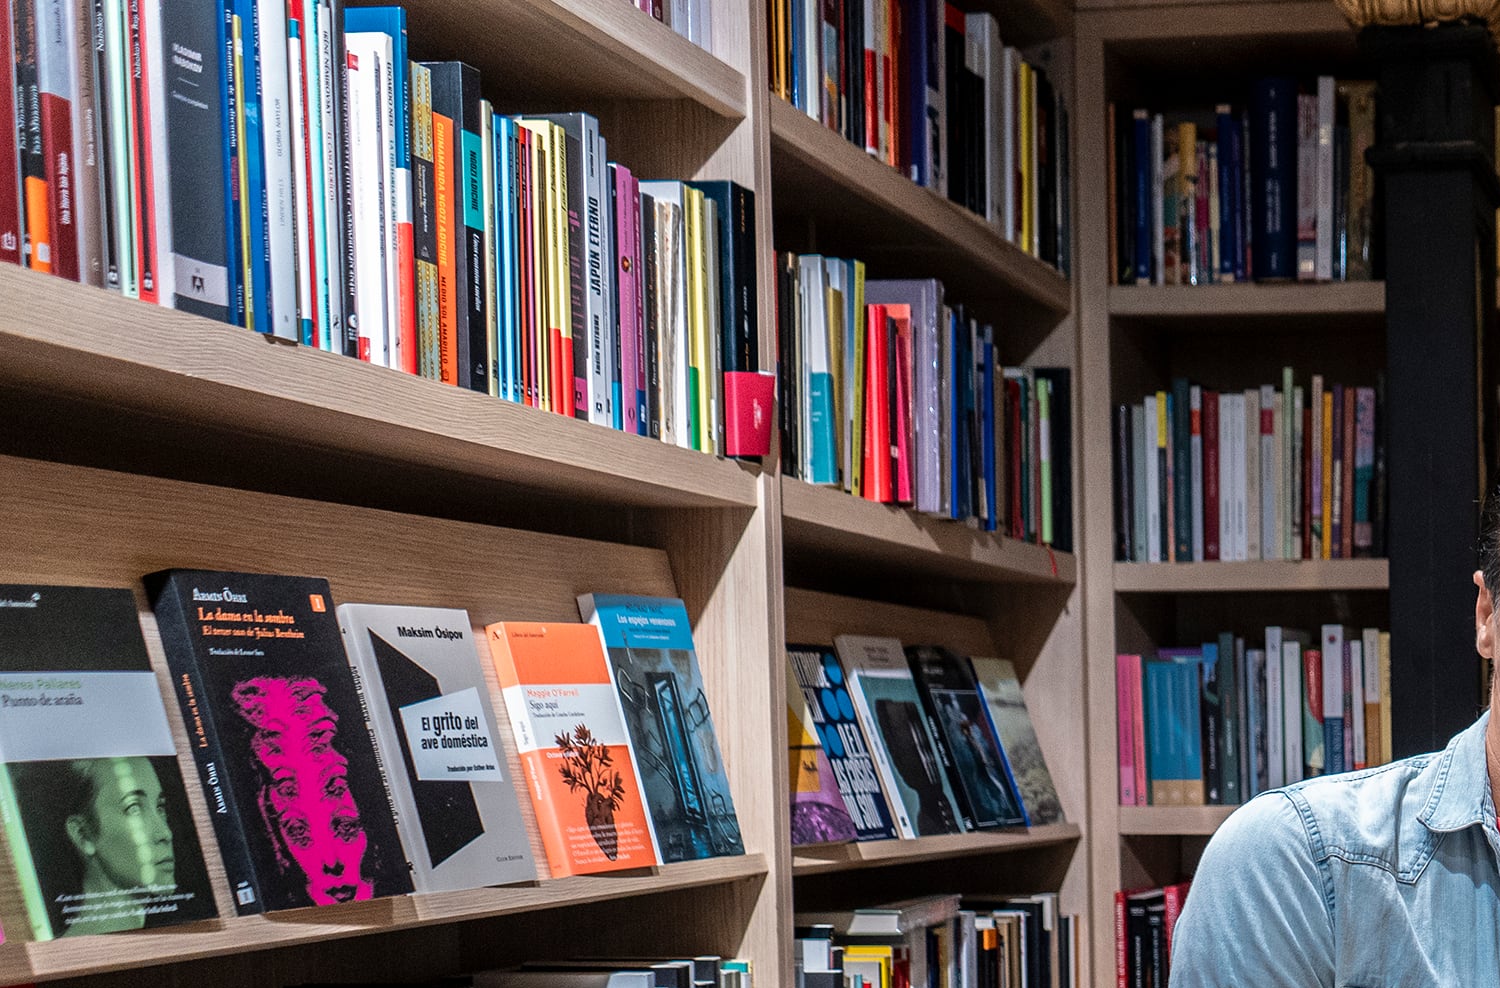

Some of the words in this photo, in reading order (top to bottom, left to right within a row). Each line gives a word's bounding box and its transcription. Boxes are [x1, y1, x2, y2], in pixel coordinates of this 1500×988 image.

[435, 122, 447, 193] CHIMAMANDA
[468, 149, 480, 175] NGOZI
[437, 194, 448, 222] NGOZI
[469, 177, 481, 212] ADICHIE
[588, 196, 600, 248] ETERNO
[438, 223, 448, 267] ADICHIE
[589, 250, 602, 297] JAPÓN
[440, 275, 448, 302] MEDIO
[441, 304, 449, 322] SOL
[442, 324, 450, 366] AMARILLO
[197, 607, 214, 621] La
[215, 608, 243, 622] dama
[244, 612, 253, 622] en
[254, 610, 264, 623] la
[397, 625, 435, 639] Maksim
[435, 624, 465, 641] Ósipov
[529, 700, 542, 711] Sigo
[543, 699, 559, 710] aquí
[421, 716, 431, 731] El
[433, 711, 462, 737] grito
[465, 715, 479, 730] del
[420, 736, 439, 750] ave
[441, 732, 489, 749] doméstica
